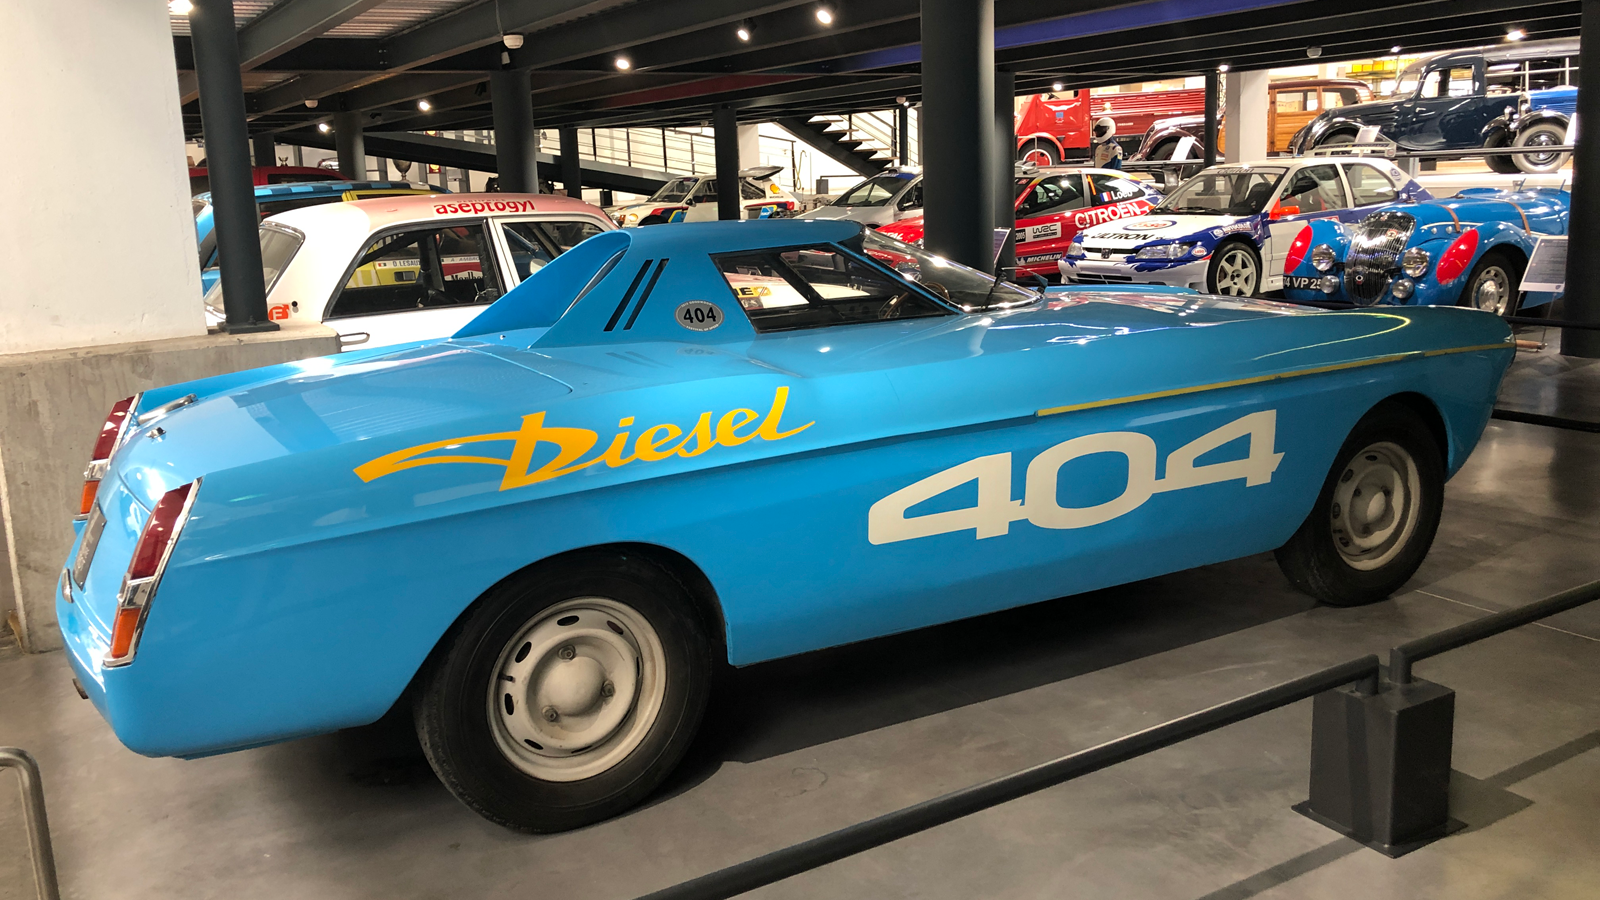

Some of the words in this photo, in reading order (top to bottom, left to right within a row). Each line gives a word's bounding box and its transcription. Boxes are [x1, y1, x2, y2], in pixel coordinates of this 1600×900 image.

[433, 199, 535, 215] aseptogyl
[1074, 202, 1142, 229] CITROËN
[1026, 253, 1062, 263] MICHELIN
[1292, 277, 1309, 288] VP
[683, 306, 716, 324] 404
[353, 385, 816, 492] Diesel
[867, 408, 1286, 546] 404
